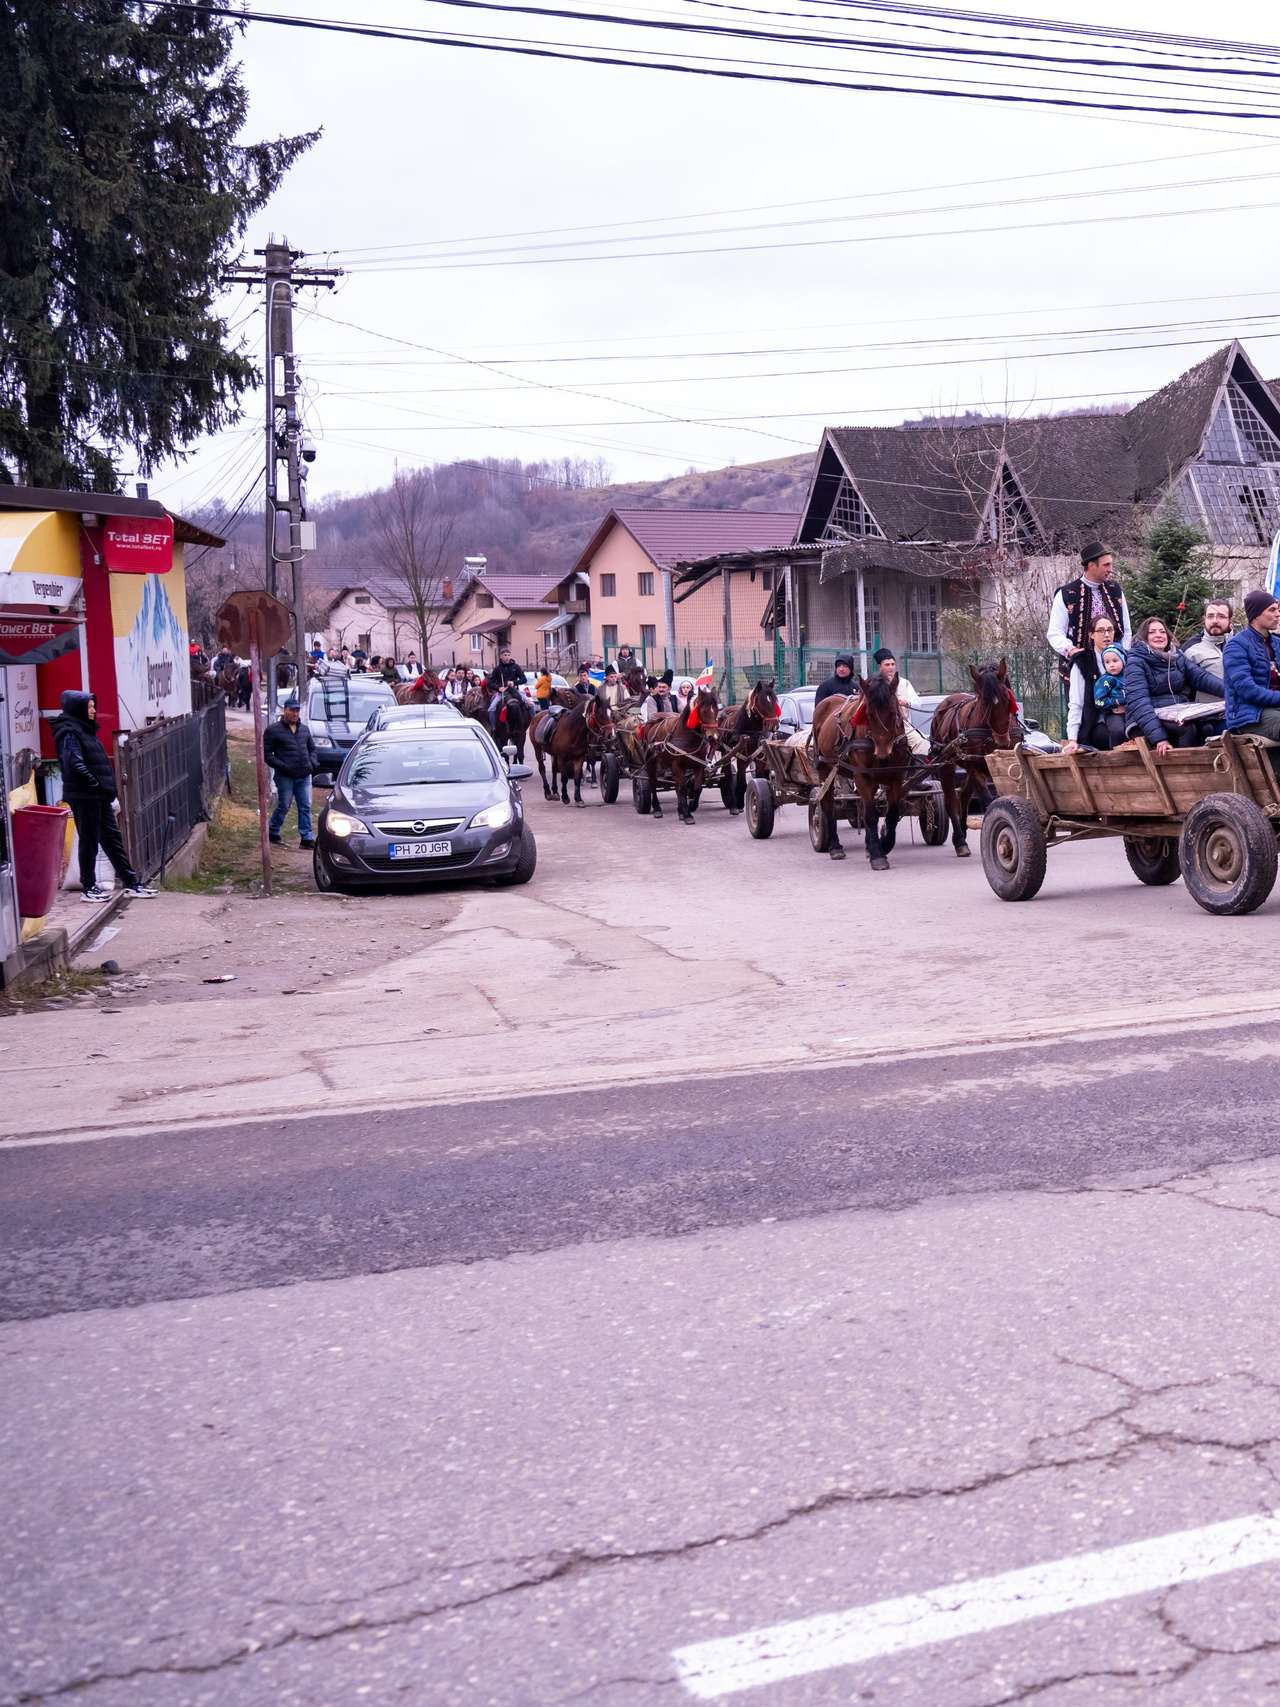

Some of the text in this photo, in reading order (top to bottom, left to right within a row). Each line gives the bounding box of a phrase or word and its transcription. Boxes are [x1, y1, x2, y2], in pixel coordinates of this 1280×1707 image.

[108, 531, 170, 545] Total BET
[0, 623, 55, 634] ower Bet
[15, 721, 34, 733] ENJOY
[395, 842, 449, 855] PH 20 JGR
